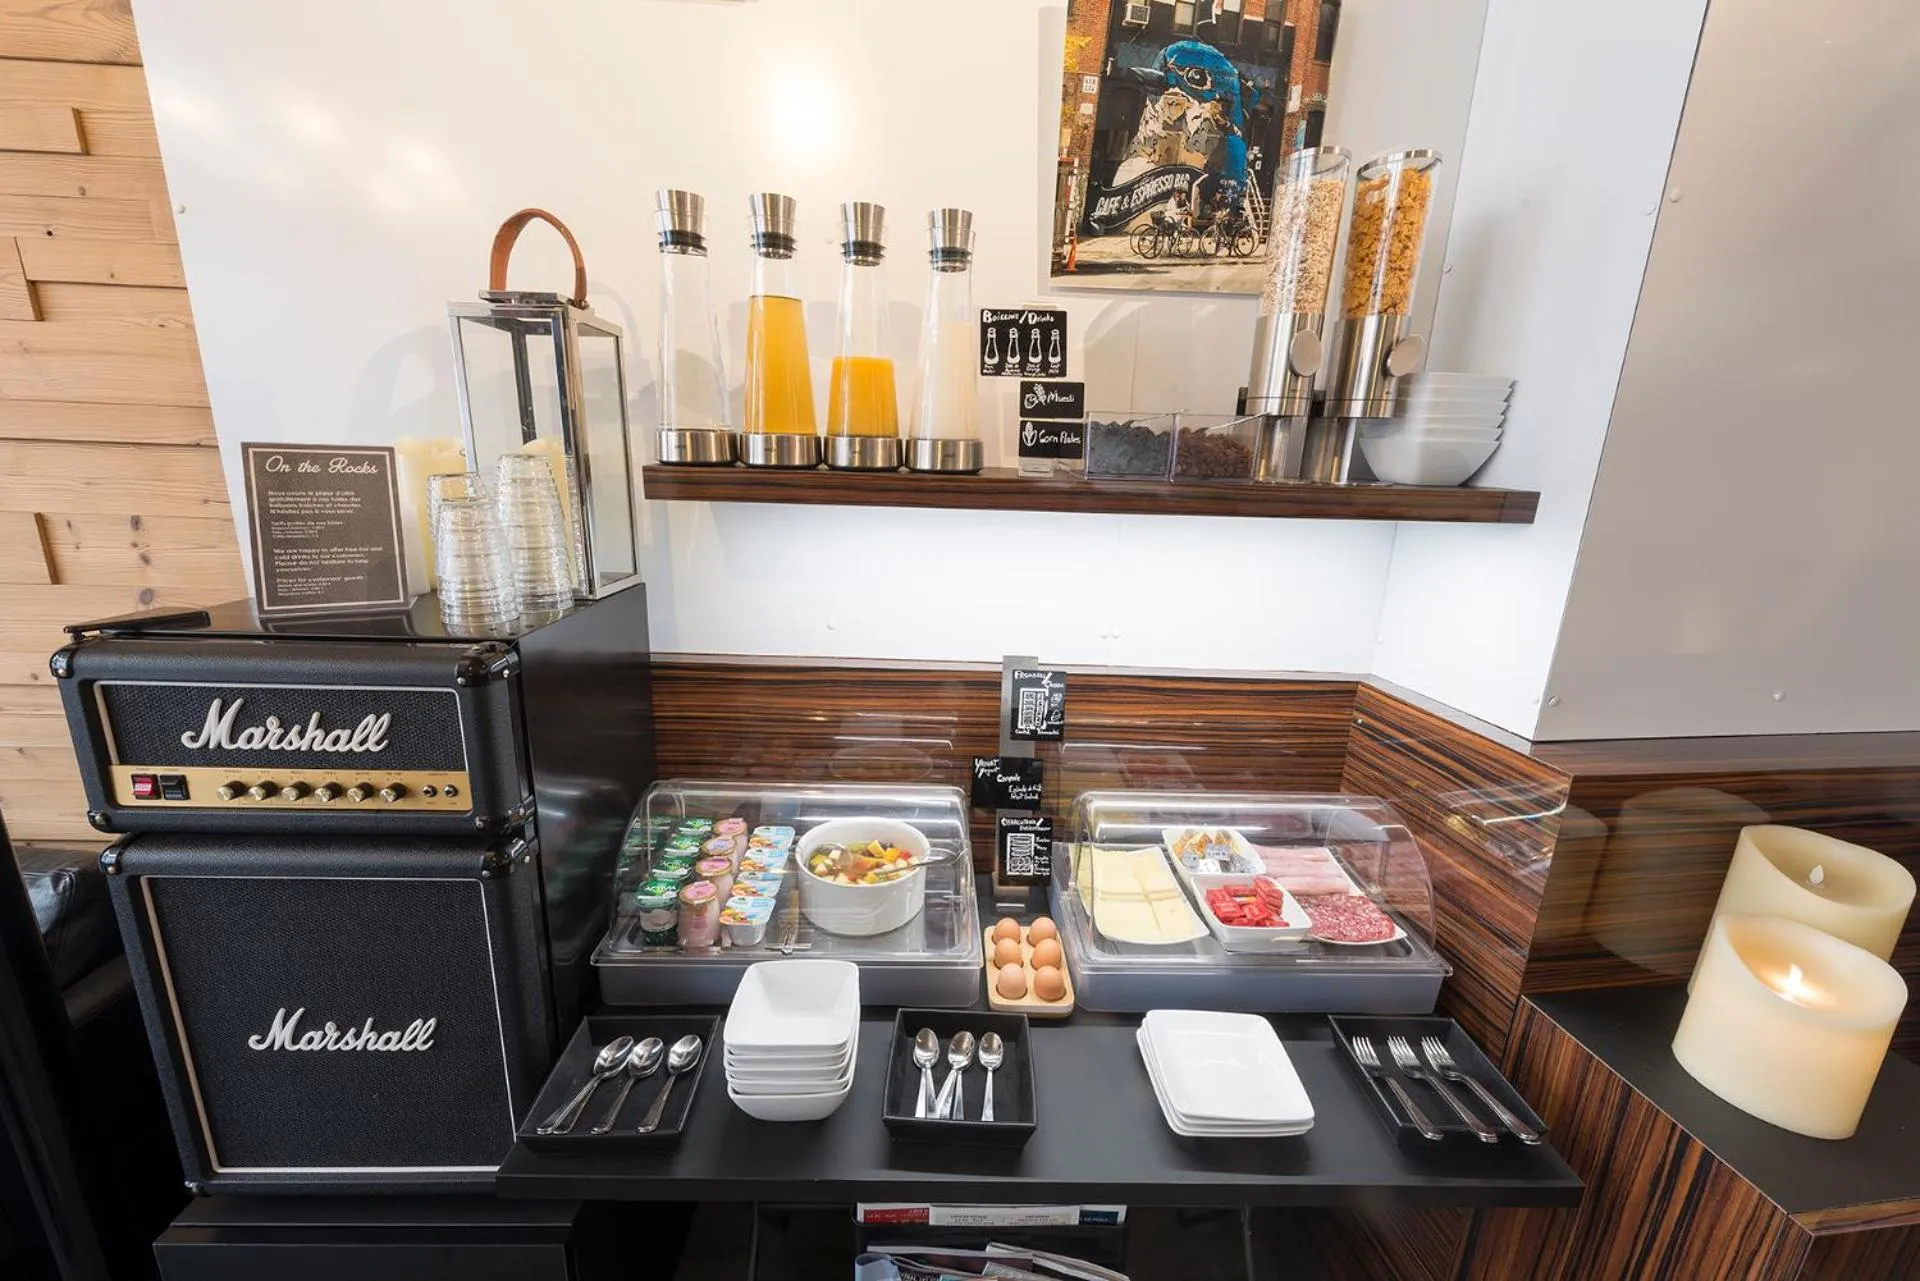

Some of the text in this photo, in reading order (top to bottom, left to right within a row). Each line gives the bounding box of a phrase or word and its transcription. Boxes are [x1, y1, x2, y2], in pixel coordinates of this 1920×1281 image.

[1038, 429, 1058, 444] Corn
[265, 454, 379, 474] On the Rocks
[181, 697, 392, 753] Marshall
[247, 1007, 438, 1052] Marshall
